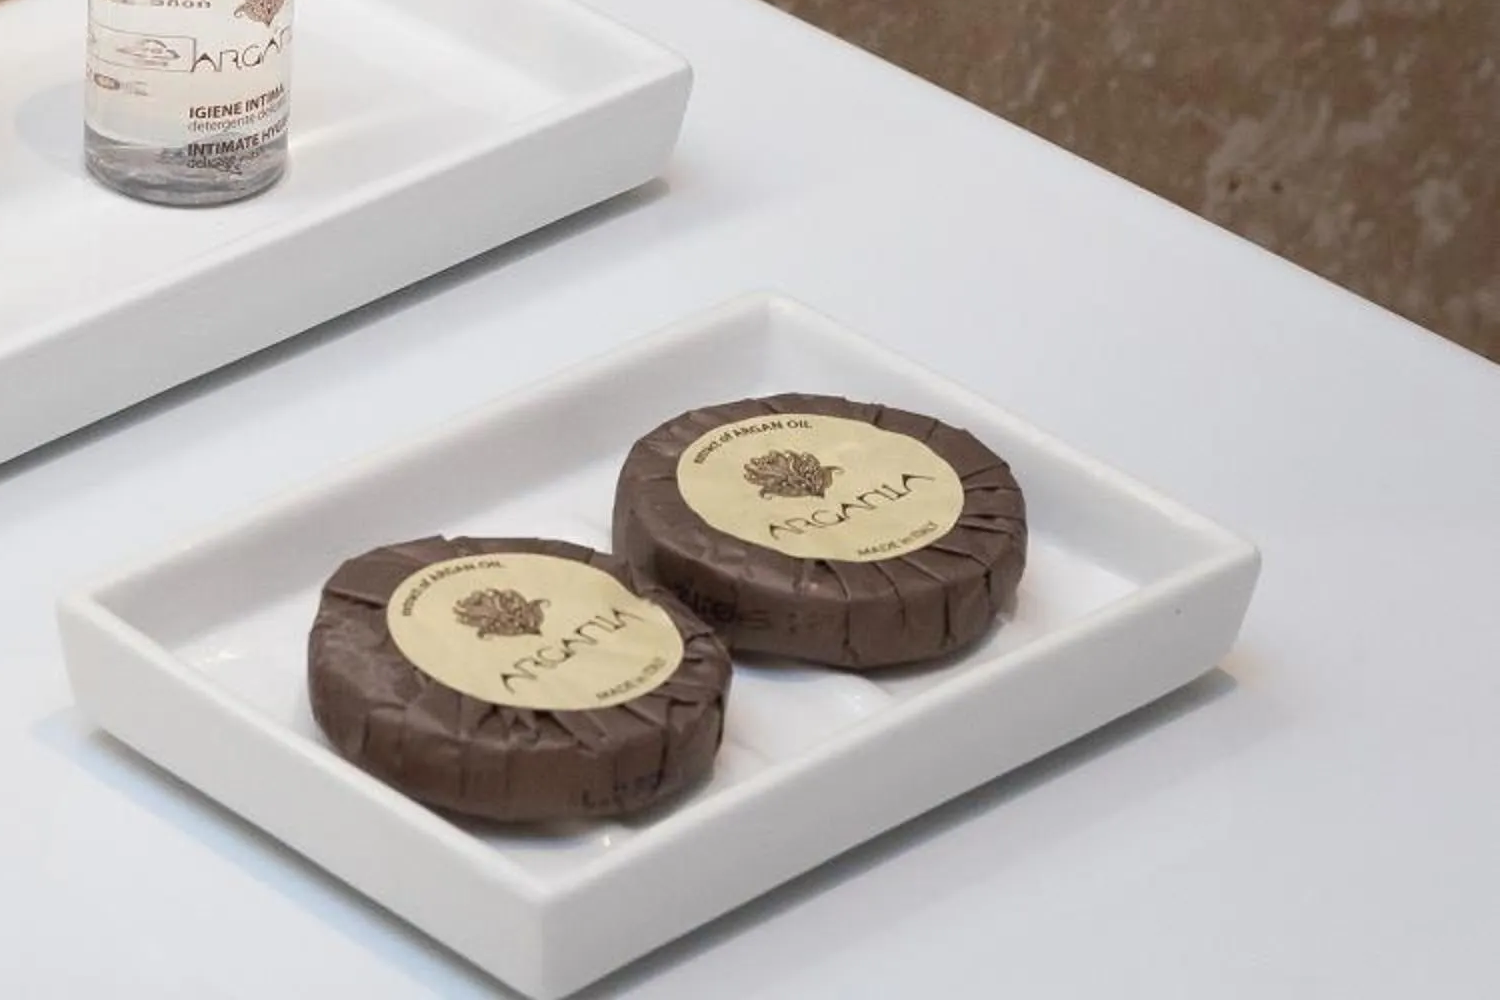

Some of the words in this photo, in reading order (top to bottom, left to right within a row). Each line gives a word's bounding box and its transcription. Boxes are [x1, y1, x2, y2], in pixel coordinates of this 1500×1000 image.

[189, 101, 242, 119] IGIENE
[187, 133, 259, 157] INTIMATE
[733, 421, 783, 438] ARGAN
[786, 419, 813, 429] OIL
[769, 473, 936, 540] ARGANIA
[858, 540, 900, 555] MADE
[500, 606, 644, 694] ARGANIA
